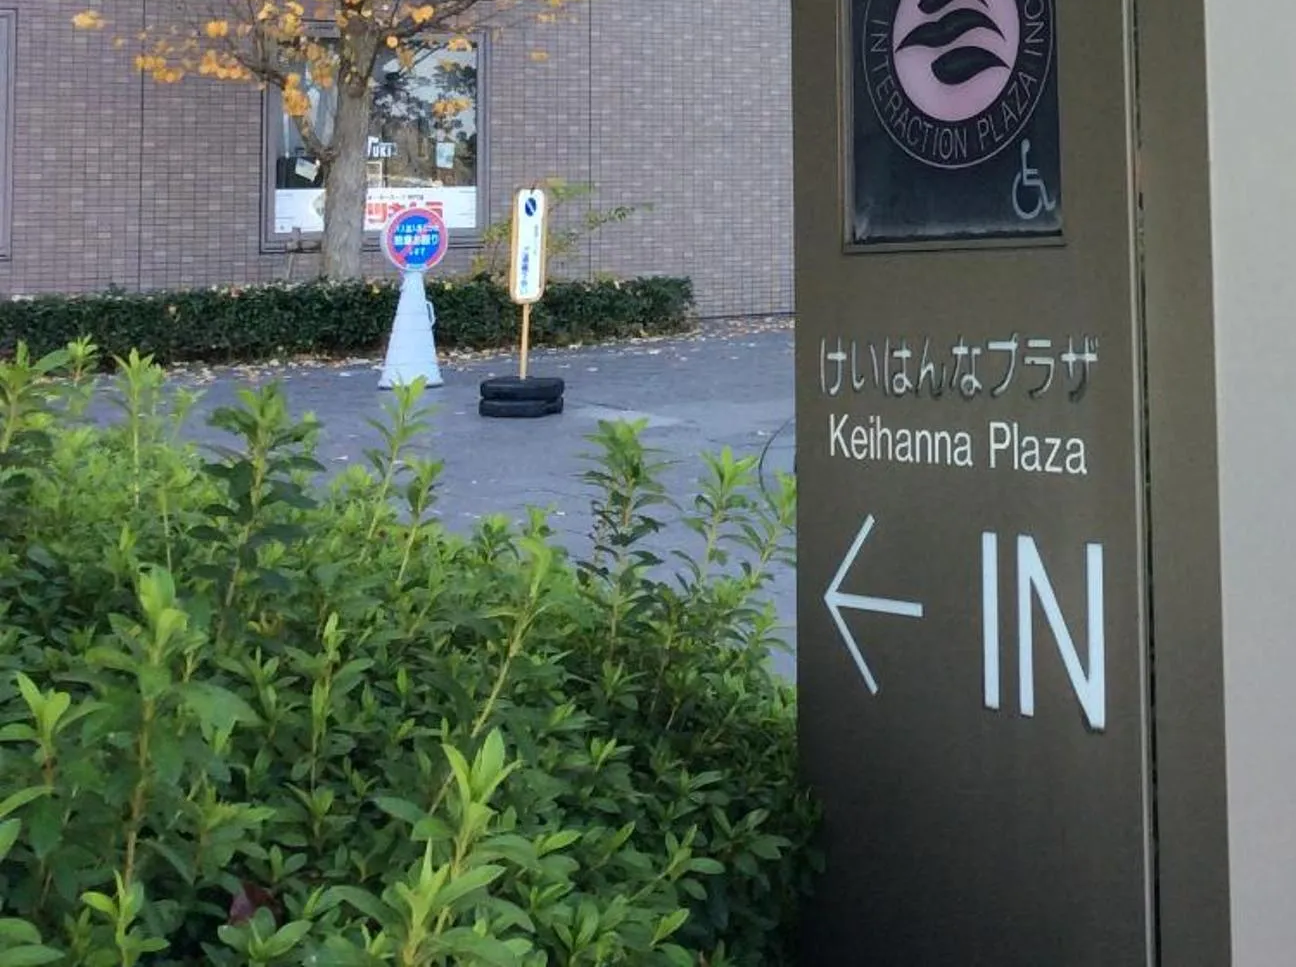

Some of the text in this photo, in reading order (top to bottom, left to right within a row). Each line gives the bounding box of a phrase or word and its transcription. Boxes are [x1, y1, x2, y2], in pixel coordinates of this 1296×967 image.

[871, 18, 968, 160] INTERACTION
[977, 69, 1038, 151] PLAZA
[819, 333, 1100, 400] けいはんなプラザ
[828, 412, 1088, 475] Keihanna Plaza
[981, 531, 1105, 730] IN
